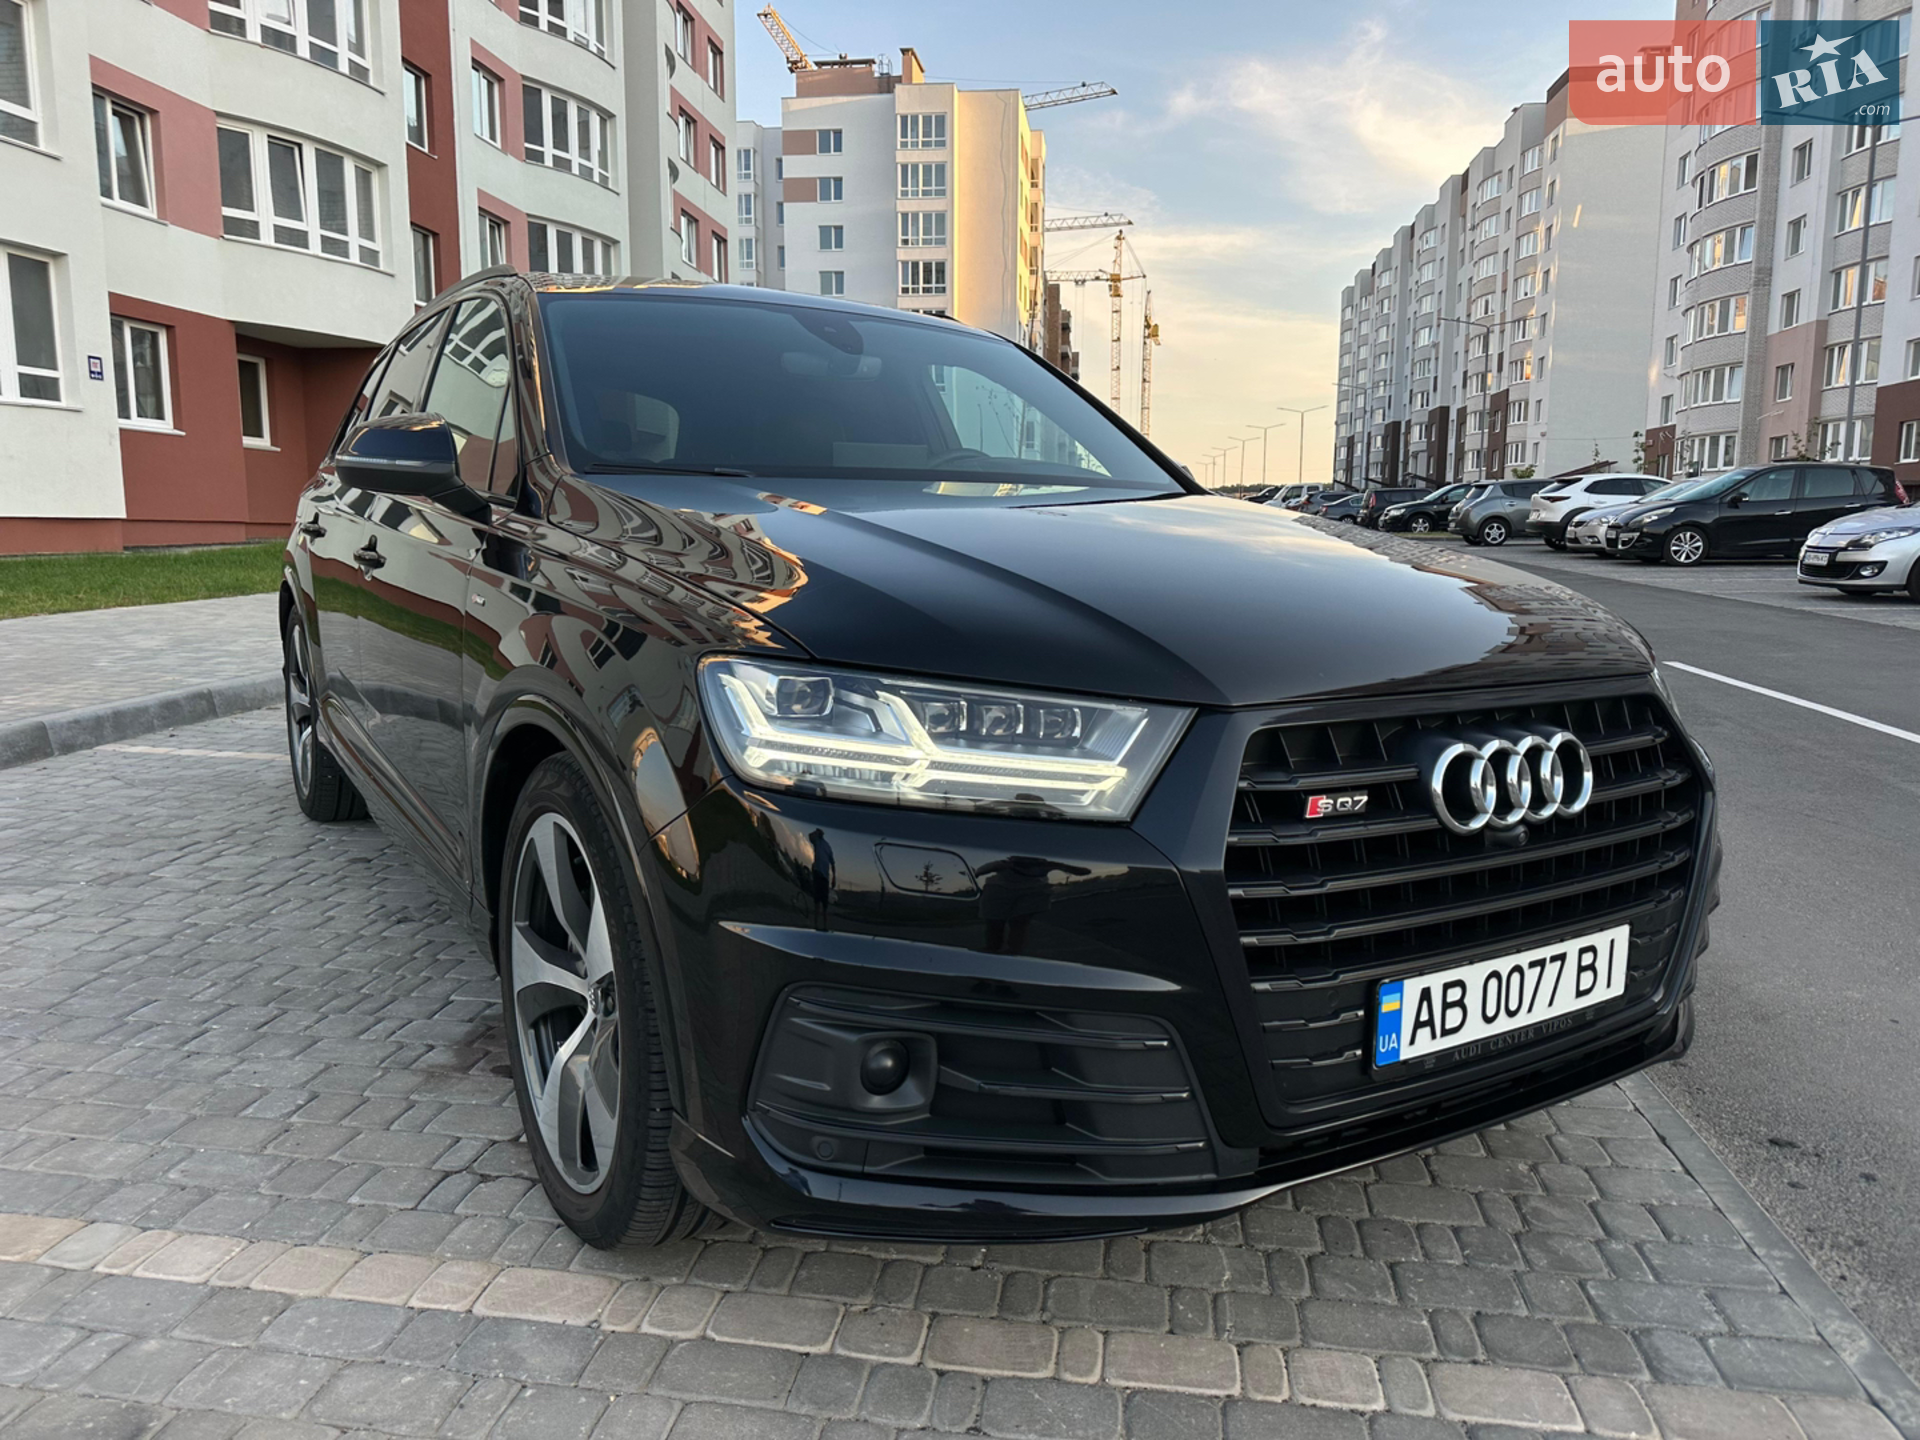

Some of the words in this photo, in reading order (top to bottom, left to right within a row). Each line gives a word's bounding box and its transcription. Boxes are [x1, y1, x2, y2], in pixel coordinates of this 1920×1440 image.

[1315, 795, 1369, 813] SQ7
[1408, 978, 1468, 1047] AB
[1481, 951, 1567, 1025] 0077
[1574, 938, 1615, 1000] BI
[1378, 1033, 1399, 1053] UA
[1452, 1043, 1482, 1062] AUDI
[1489, 1028, 1535, 1050] CENTER
